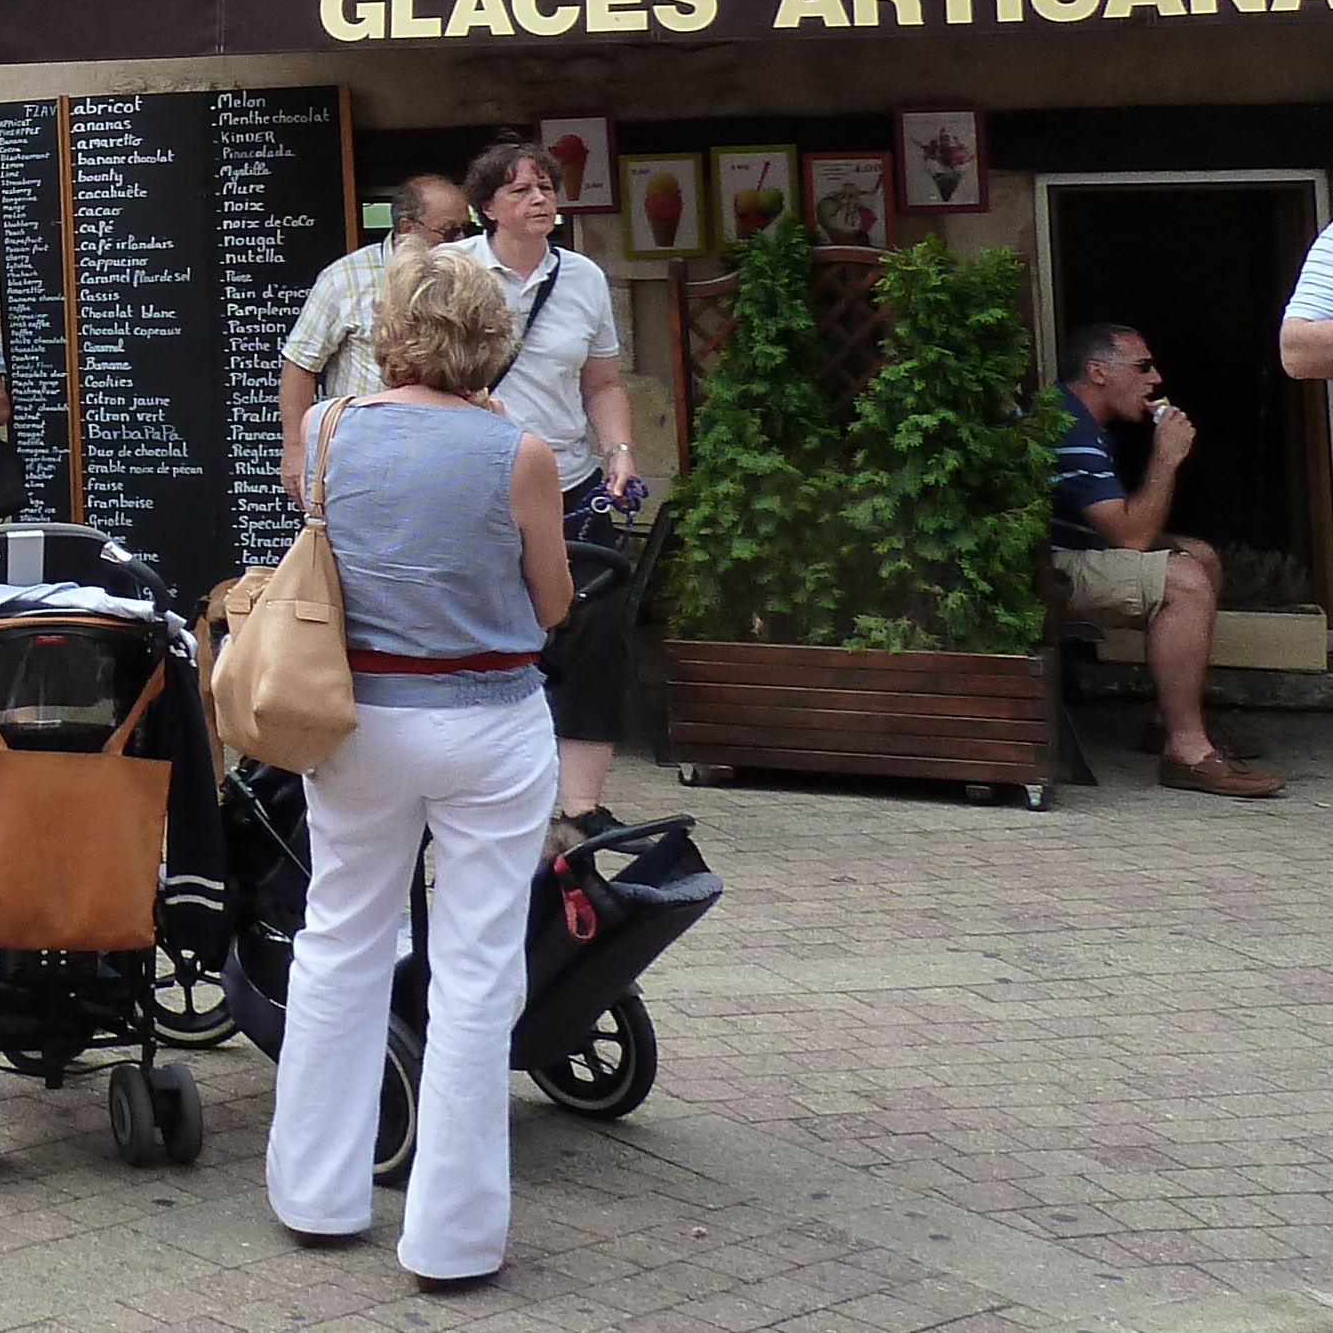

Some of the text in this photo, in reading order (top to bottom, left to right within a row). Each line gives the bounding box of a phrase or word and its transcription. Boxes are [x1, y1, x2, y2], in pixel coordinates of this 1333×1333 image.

[73, 95, 144, 115] abricot
[217, 89, 267, 109] Melon
[219, 106, 331, 126] Menthe chocolat
[72, 119, 132, 133] ananas
[76, 133, 144, 150] amaretto
[77, 148, 176, 166] banane chocolat
[77, 168, 124, 187] bounty
[77, 207, 124, 217] cacao
[223, 198, 266, 212] noix
[79, 220, 115, 238] café
[222, 217, 260, 230] noix
[264, 213, 282, 228] de
[80, 237, 114, 255] café
[223, 228, 286, 253] nougat
[225, 247, 287, 264] nutella
[80, 268, 130, 285] Caramel
[79, 289, 121, 302] Cassis
[224, 286, 257, 300] Pain
[81, 303, 178, 319] Chocolat blanc
[81, 321, 131, 336] Chocolat
[227, 318, 288, 333] Passion
[84, 374, 134, 388] Cookies
[85, 391, 171, 411] Citron jaune
[85, 407, 166, 422] Citron vert
[87, 441, 189, 458] Duo de chocolat
[86, 477, 125, 492] fraise
[87, 493, 155, 510] framboise
[237, 496, 283, 513] Smart
[241, 548, 281, 565] tarte
